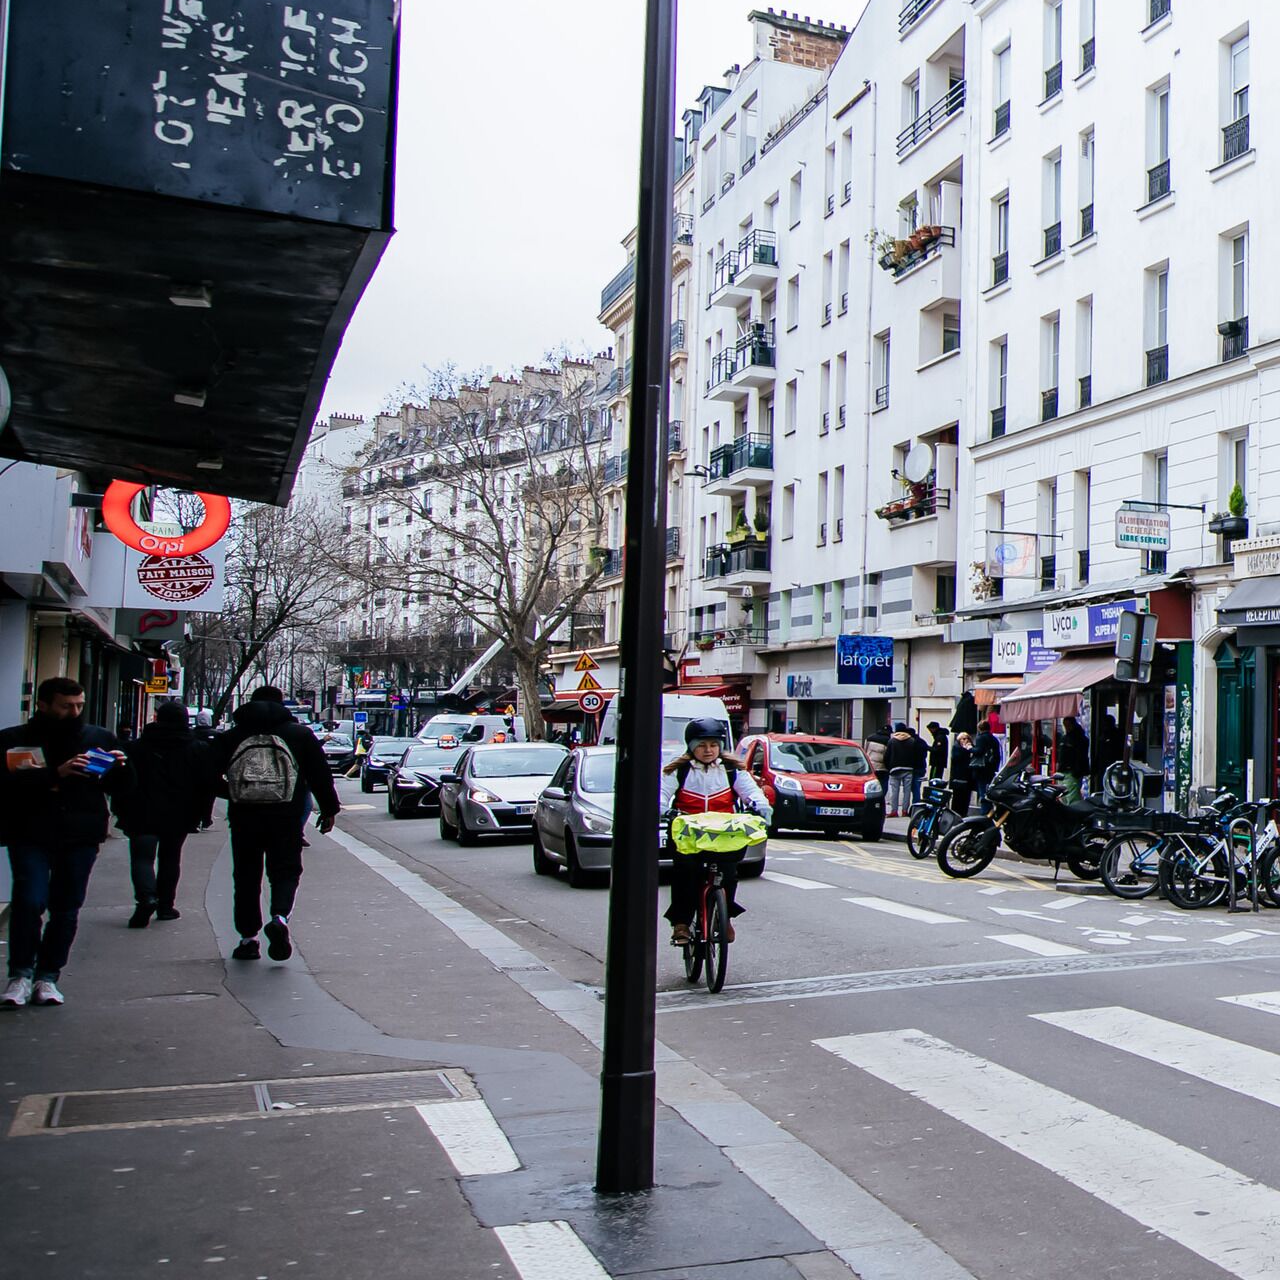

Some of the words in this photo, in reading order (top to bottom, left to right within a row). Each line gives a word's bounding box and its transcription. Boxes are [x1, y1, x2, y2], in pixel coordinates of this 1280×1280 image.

[1118, 516, 1169, 528] ALIMENTATION
[139, 535, 185, 554] Orpi
[1119, 534, 1139, 542] LIBRE
[1140, 536, 1167, 545] SERVICE
[139, 570, 165, 580] FAIT
[169, 567, 213, 578] MAISON
[159, 587, 194, 599] 100%
[1052, 614, 1072, 635] Lyca
[997, 639, 1017, 659] Lyca
[839, 652, 891, 668] laforêt
[585, 696, 598, 706] 30
